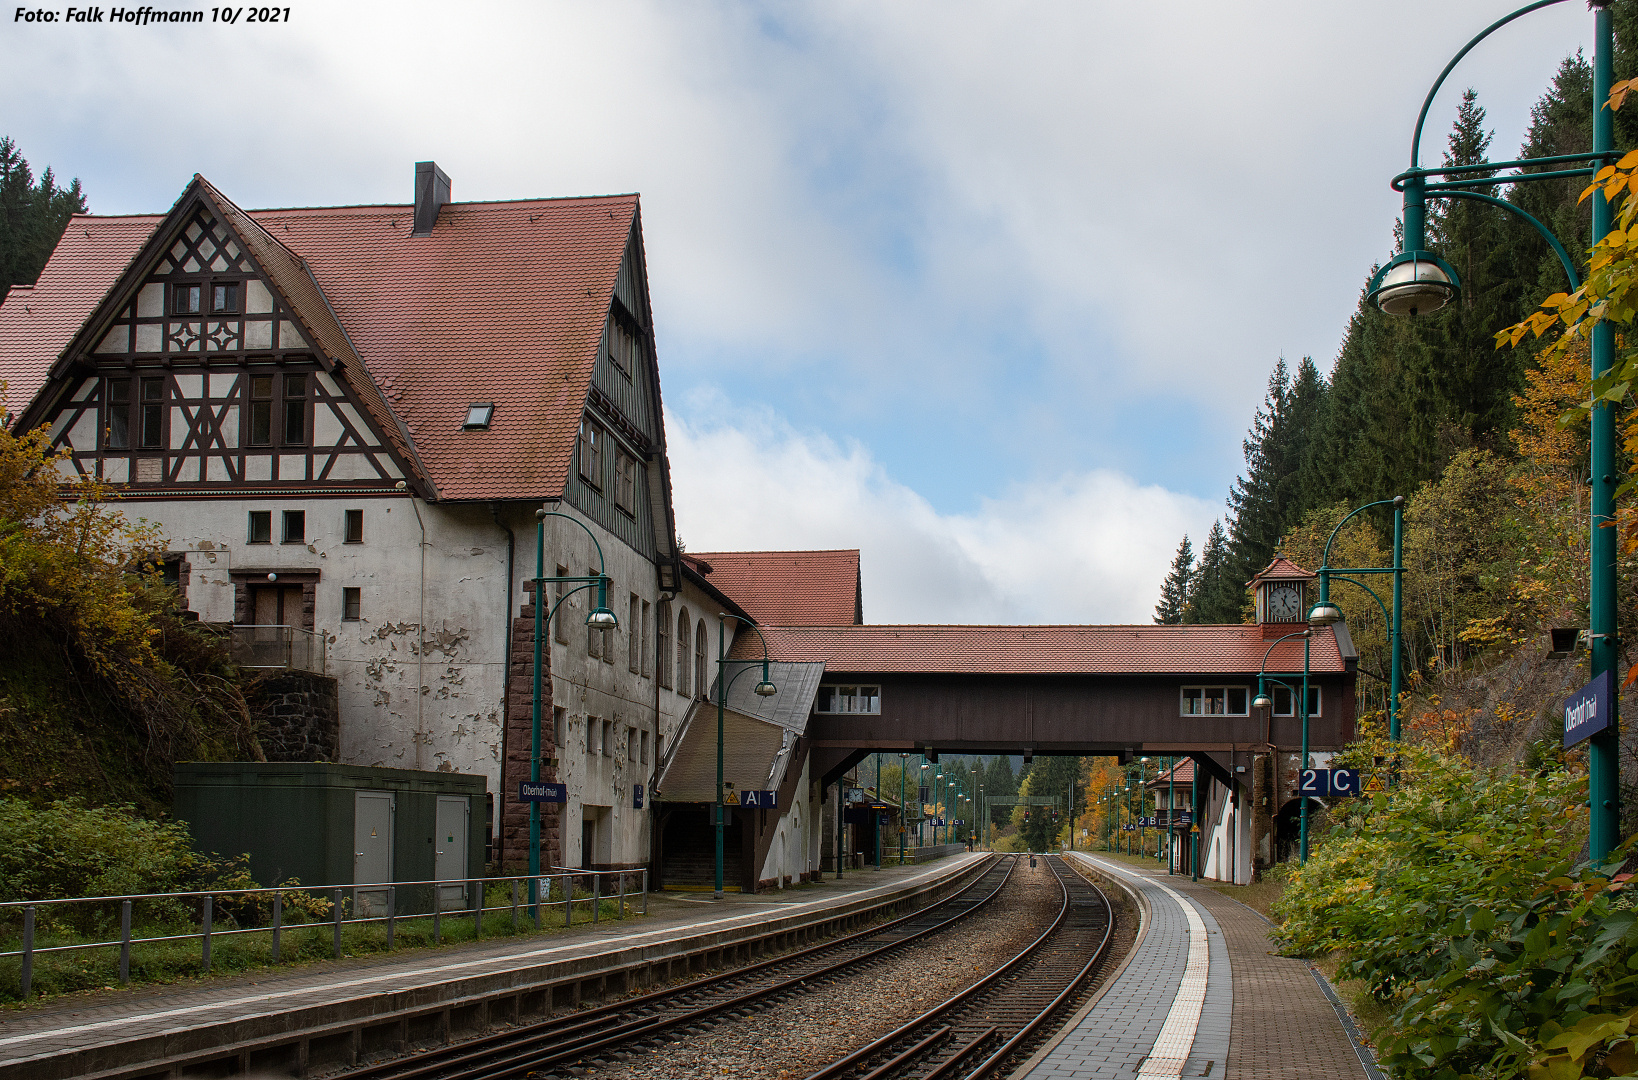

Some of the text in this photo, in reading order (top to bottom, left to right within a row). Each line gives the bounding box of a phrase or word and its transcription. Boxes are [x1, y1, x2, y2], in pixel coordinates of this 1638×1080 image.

[1566, 696, 1585, 732] Oberhof
[1302, 770, 1350, 791] 2 C
[523, 784, 545, 796] Oberhof
[746, 791, 775, 804] A 1
[932, 818, 937, 826] B
[1139, 816, 1156, 825] 2 B
